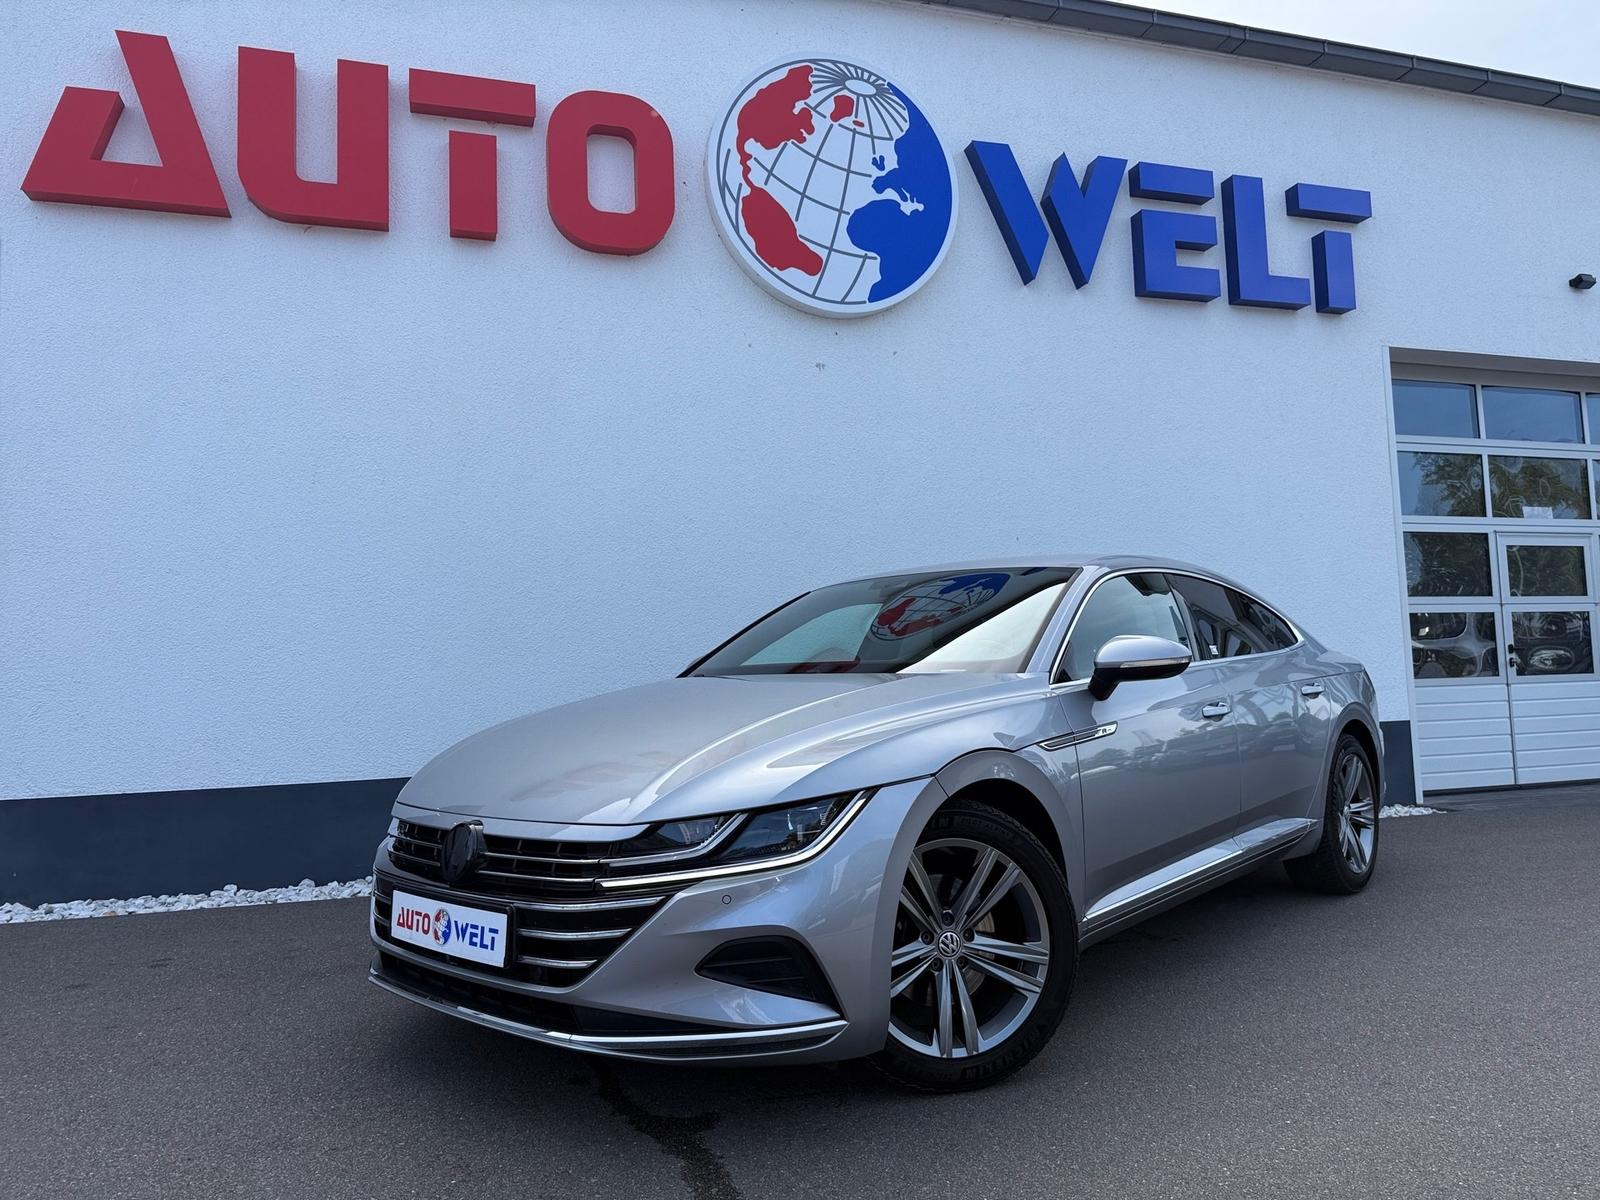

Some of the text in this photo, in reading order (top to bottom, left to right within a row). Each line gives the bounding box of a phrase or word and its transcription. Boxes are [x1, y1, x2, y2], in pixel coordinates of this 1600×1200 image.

[20, 30, 1372, 314] AUTO WELT
[396, 907, 499, 951] AUTO WELT
